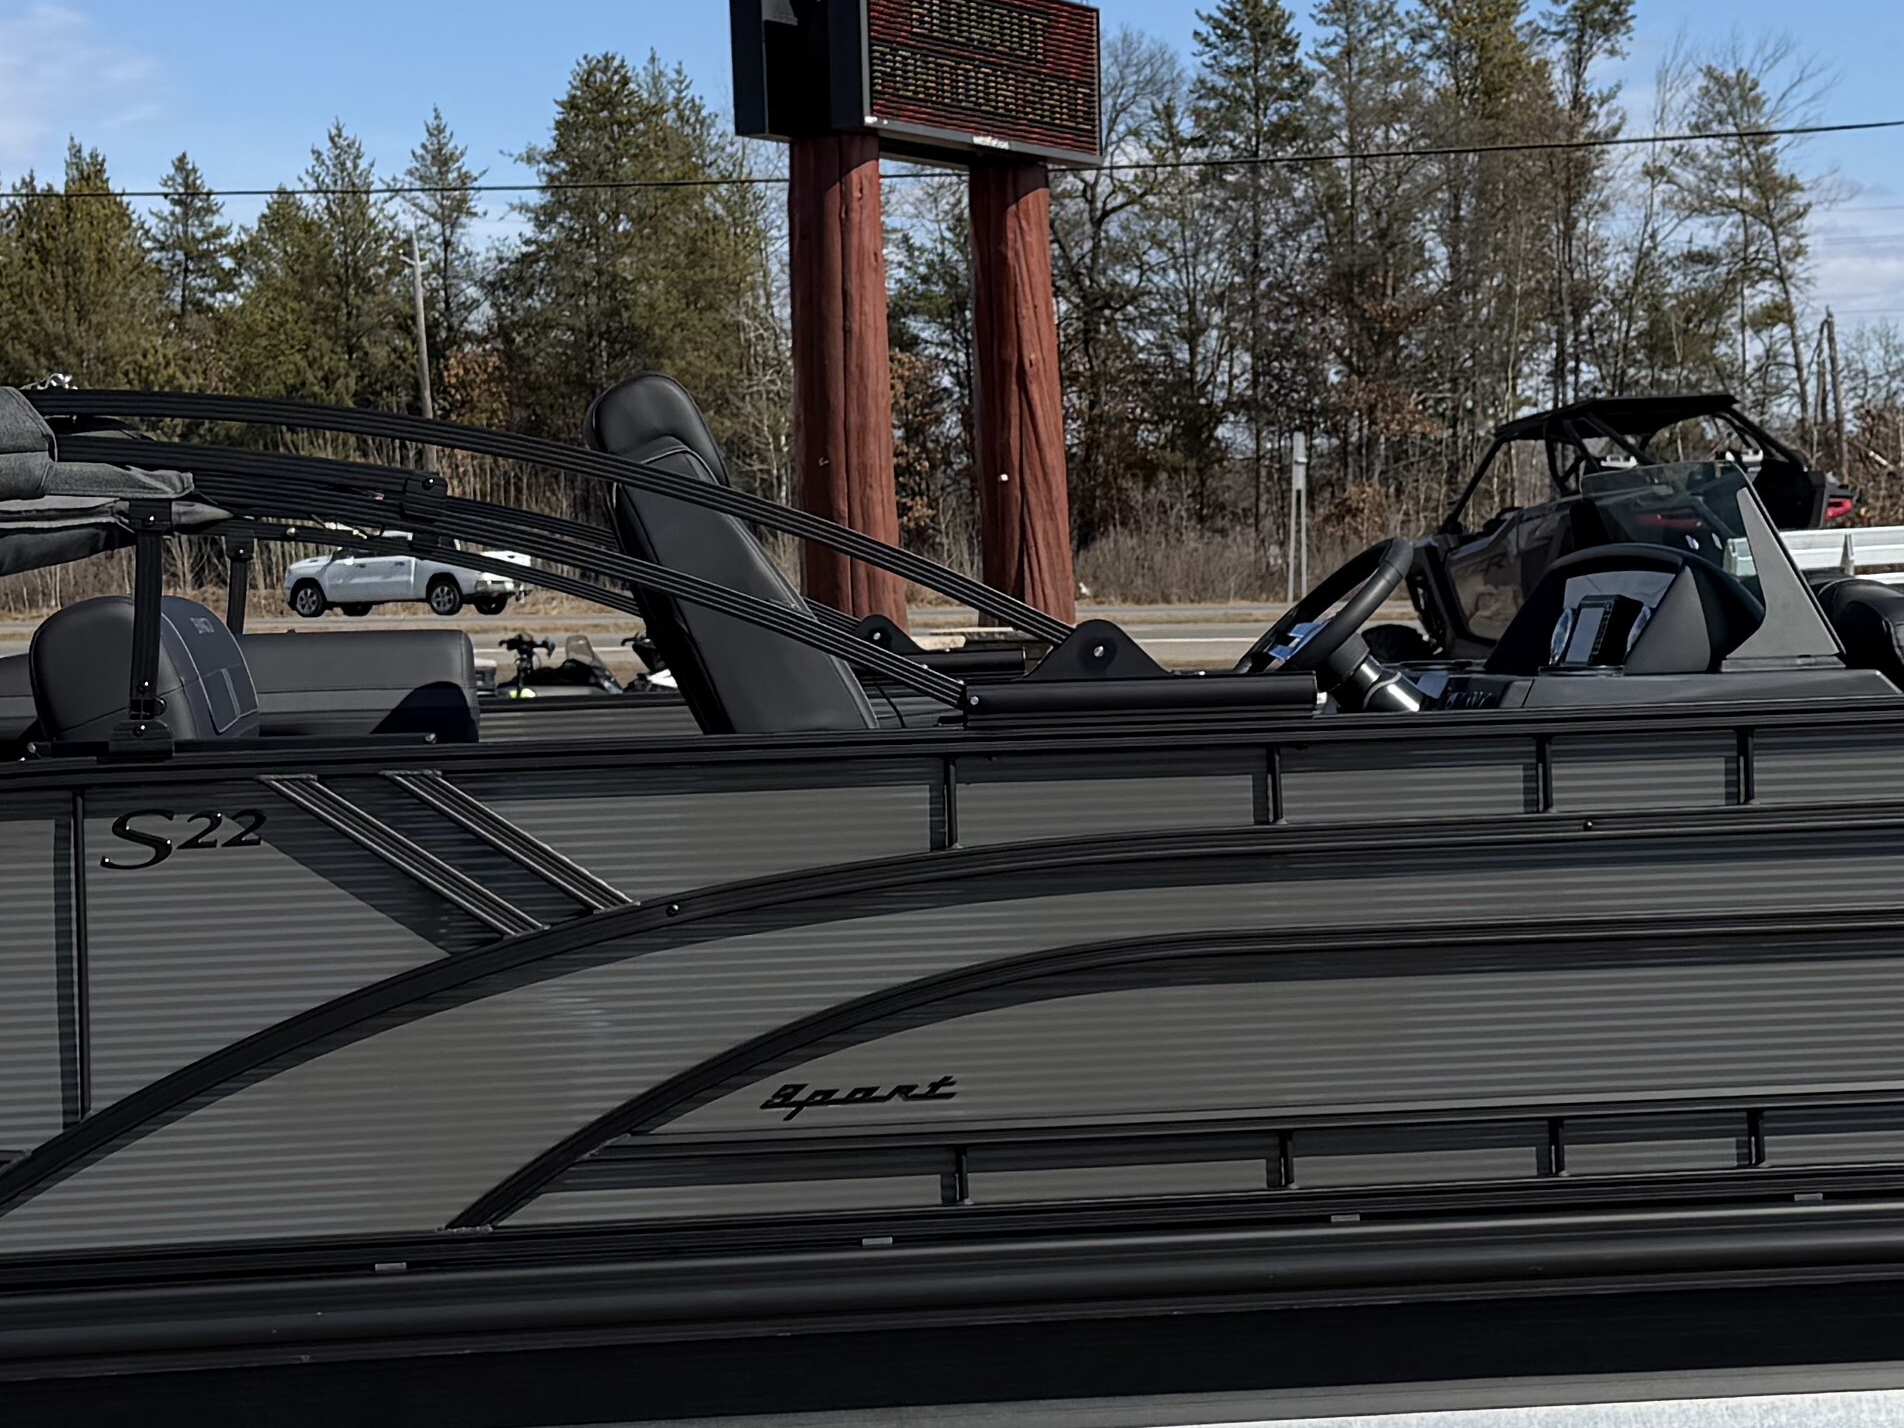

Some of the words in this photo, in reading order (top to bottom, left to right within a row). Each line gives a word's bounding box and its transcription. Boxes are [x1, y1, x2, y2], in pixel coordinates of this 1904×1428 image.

[872, 44, 1016, 116] PONTOON
[1025, 76, 1092, 130] SALE
[99, 808, 268, 870] S22
[759, 1075, 958, 1121] Sport
